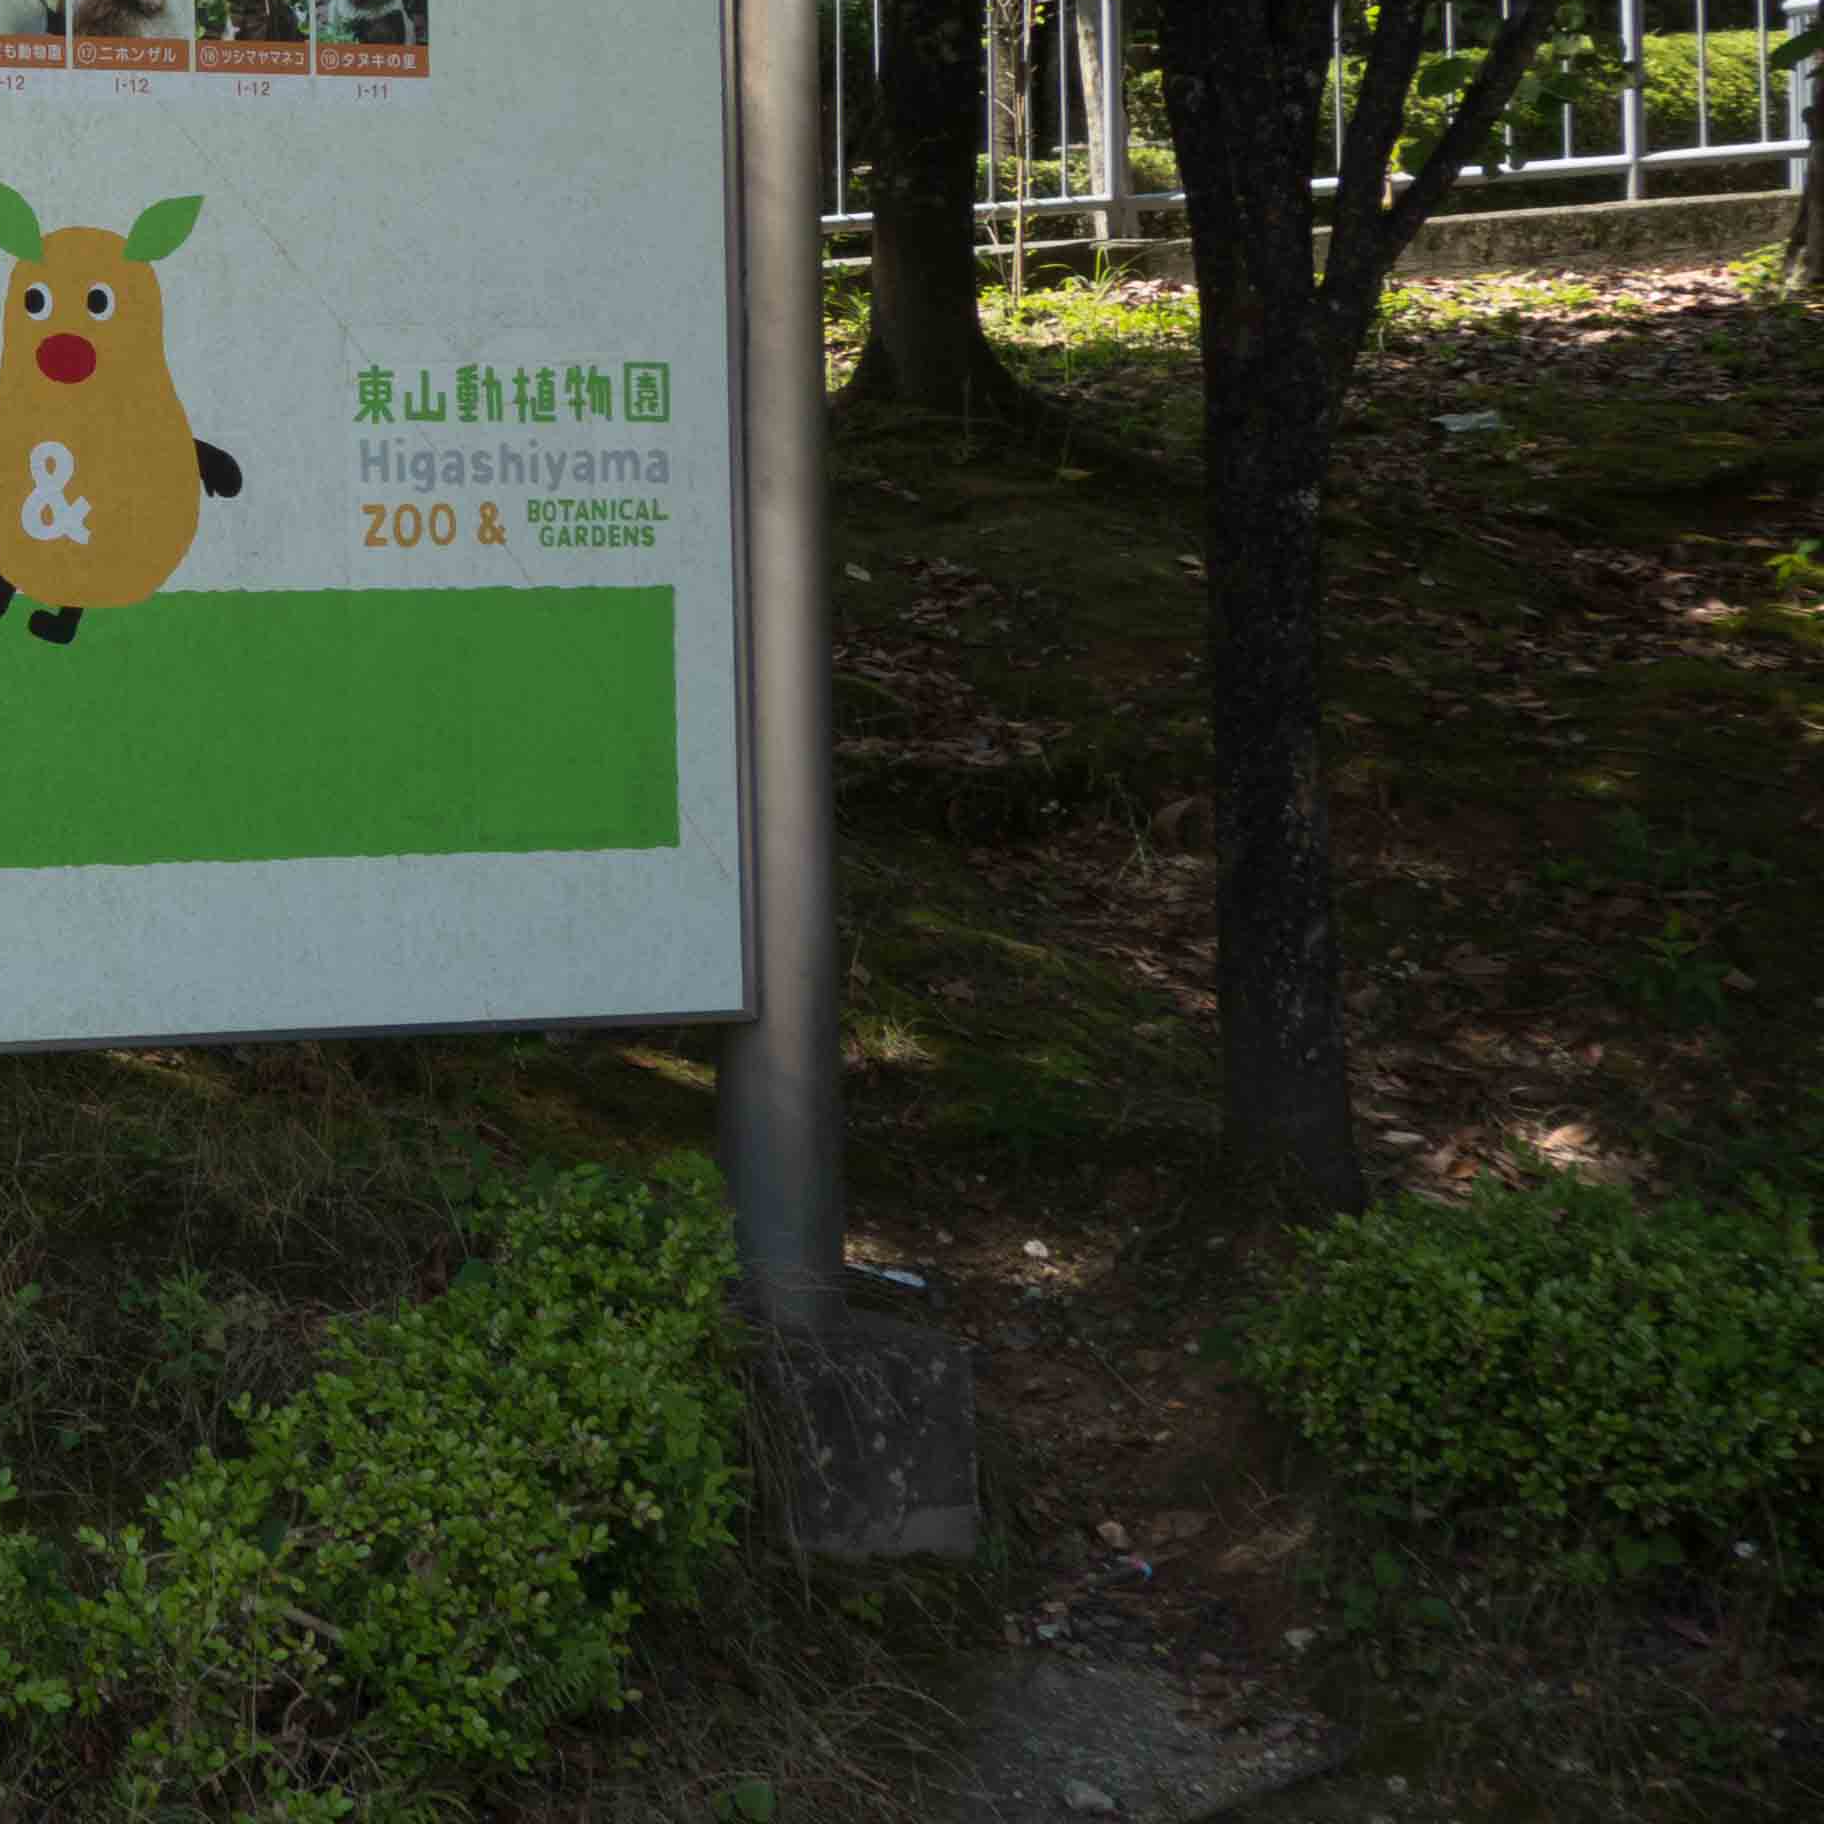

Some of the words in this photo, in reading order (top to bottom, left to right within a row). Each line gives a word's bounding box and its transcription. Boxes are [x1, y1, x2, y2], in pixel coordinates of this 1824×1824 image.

[353, 362, 670, 424] 東山動植物園
[359, 438, 670, 493] Higashiyama
[21, 440, 91, 545] &
[528, 498, 668, 522] BOTANICAL
[361, 503, 457, 548] ZOO
[478, 502, 506, 545] &
[539, 525, 655, 547] GARDENS
